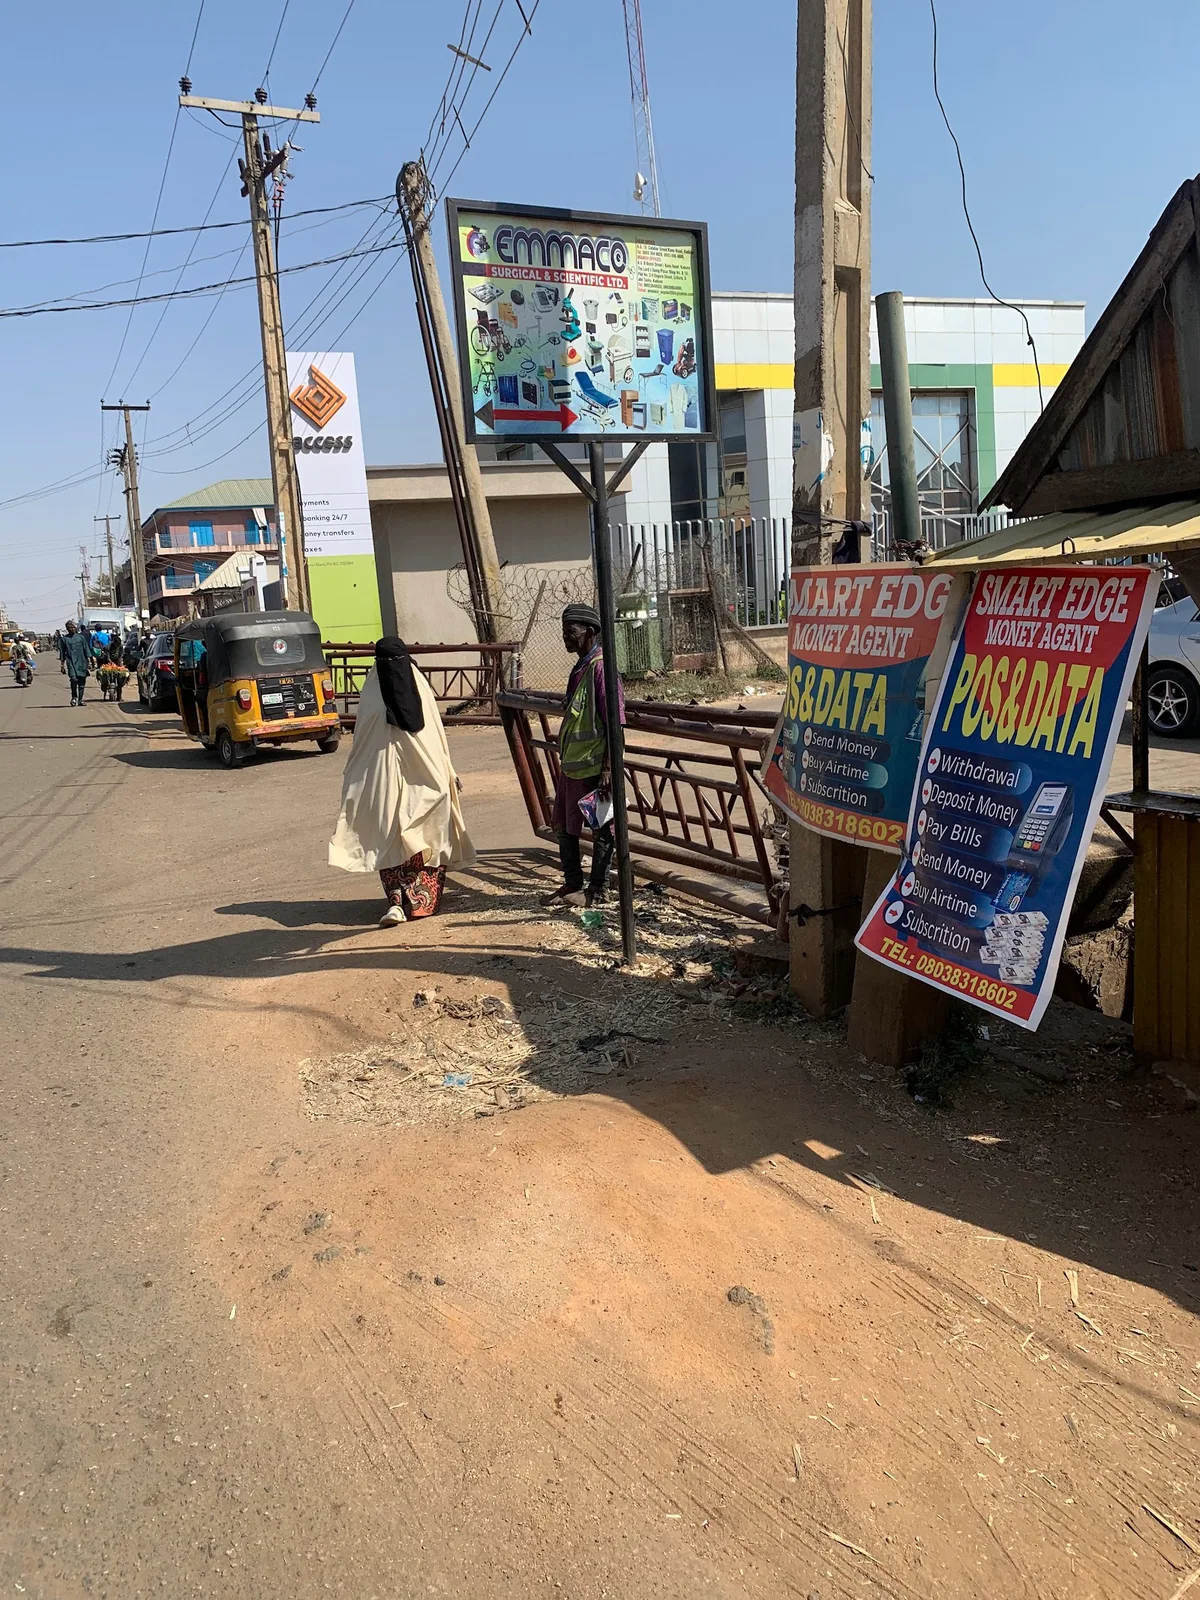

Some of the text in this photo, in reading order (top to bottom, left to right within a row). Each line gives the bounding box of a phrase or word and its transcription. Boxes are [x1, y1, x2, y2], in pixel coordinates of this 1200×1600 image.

[494, 226, 630, 274] EMMACO
[491, 267, 542, 280] SURGICAL
[544, 272, 551, 281] &
[554, 272, 605, 286] SCIENTIFIC
[607, 278, 627, 289] LTD.
[293, 436, 353, 453] access
[322, 529, 355, 537] transfers
[332, 513, 348, 521] 24/7
[789, 573, 954, 620] MART EDG
[976, 574, 1137, 623] SMART EDGE
[793, 623, 914, 658] MONEY AGENT
[984, 619, 1100, 653] MONEY AGENT
[784, 665, 887, 736] S&DATA
[942, 653, 1105, 759] POS&DATA
[812, 732, 835, 749] Send
[836, 737, 878, 760] Money
[808, 755, 825, 773] Buy
[825, 760, 870, 781] Airtime
[941, 754, 1021, 788] Withdrawal
[807, 777, 868, 807] Subscrition
[930, 784, 1019, 827] Deposit Money
[926, 817, 982, 847] Pay Bills
[918, 848, 944, 871] Send
[944, 856, 992, 890] Money
[913, 880, 930, 904] Buy
[929, 887, 978, 918] Airtime
[901, 910, 971, 953] Subscrition
[879, 937, 1018, 1010] TEL: 08038318602
